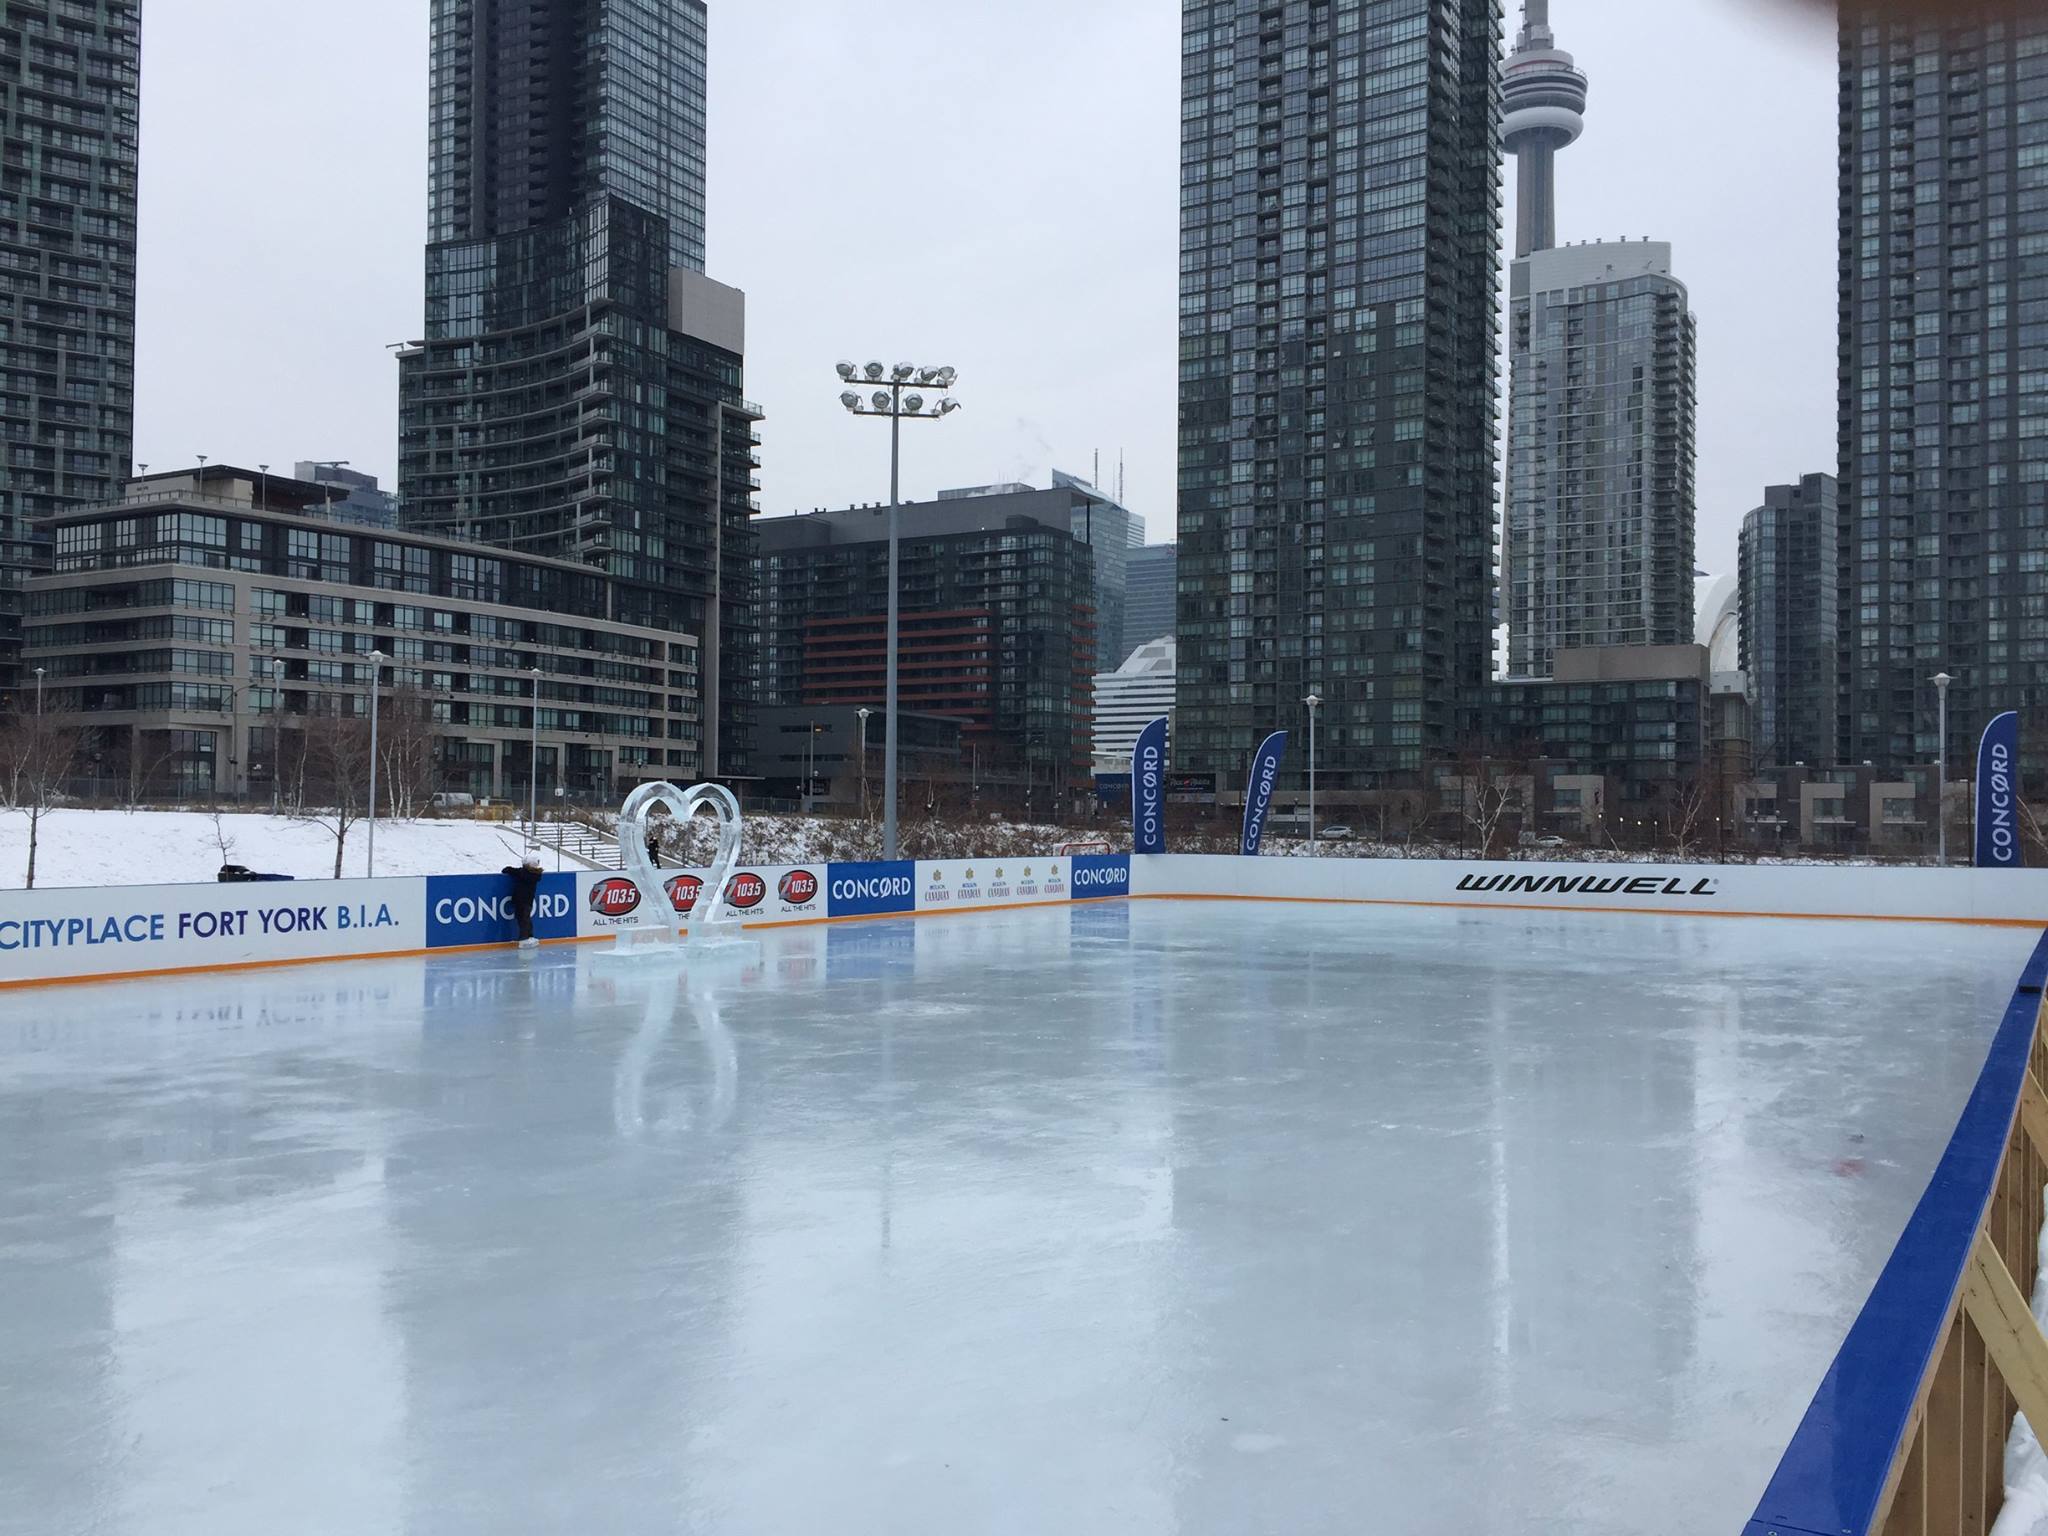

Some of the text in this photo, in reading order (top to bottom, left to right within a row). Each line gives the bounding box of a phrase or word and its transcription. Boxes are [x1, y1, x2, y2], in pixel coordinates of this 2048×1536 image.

[1455, 874, 1719, 896] WINNWELL
[435, 894, 570, 924] CONCRD
[0, 903, 400, 950] CITYPLACE FORT YORK B.I.A.
